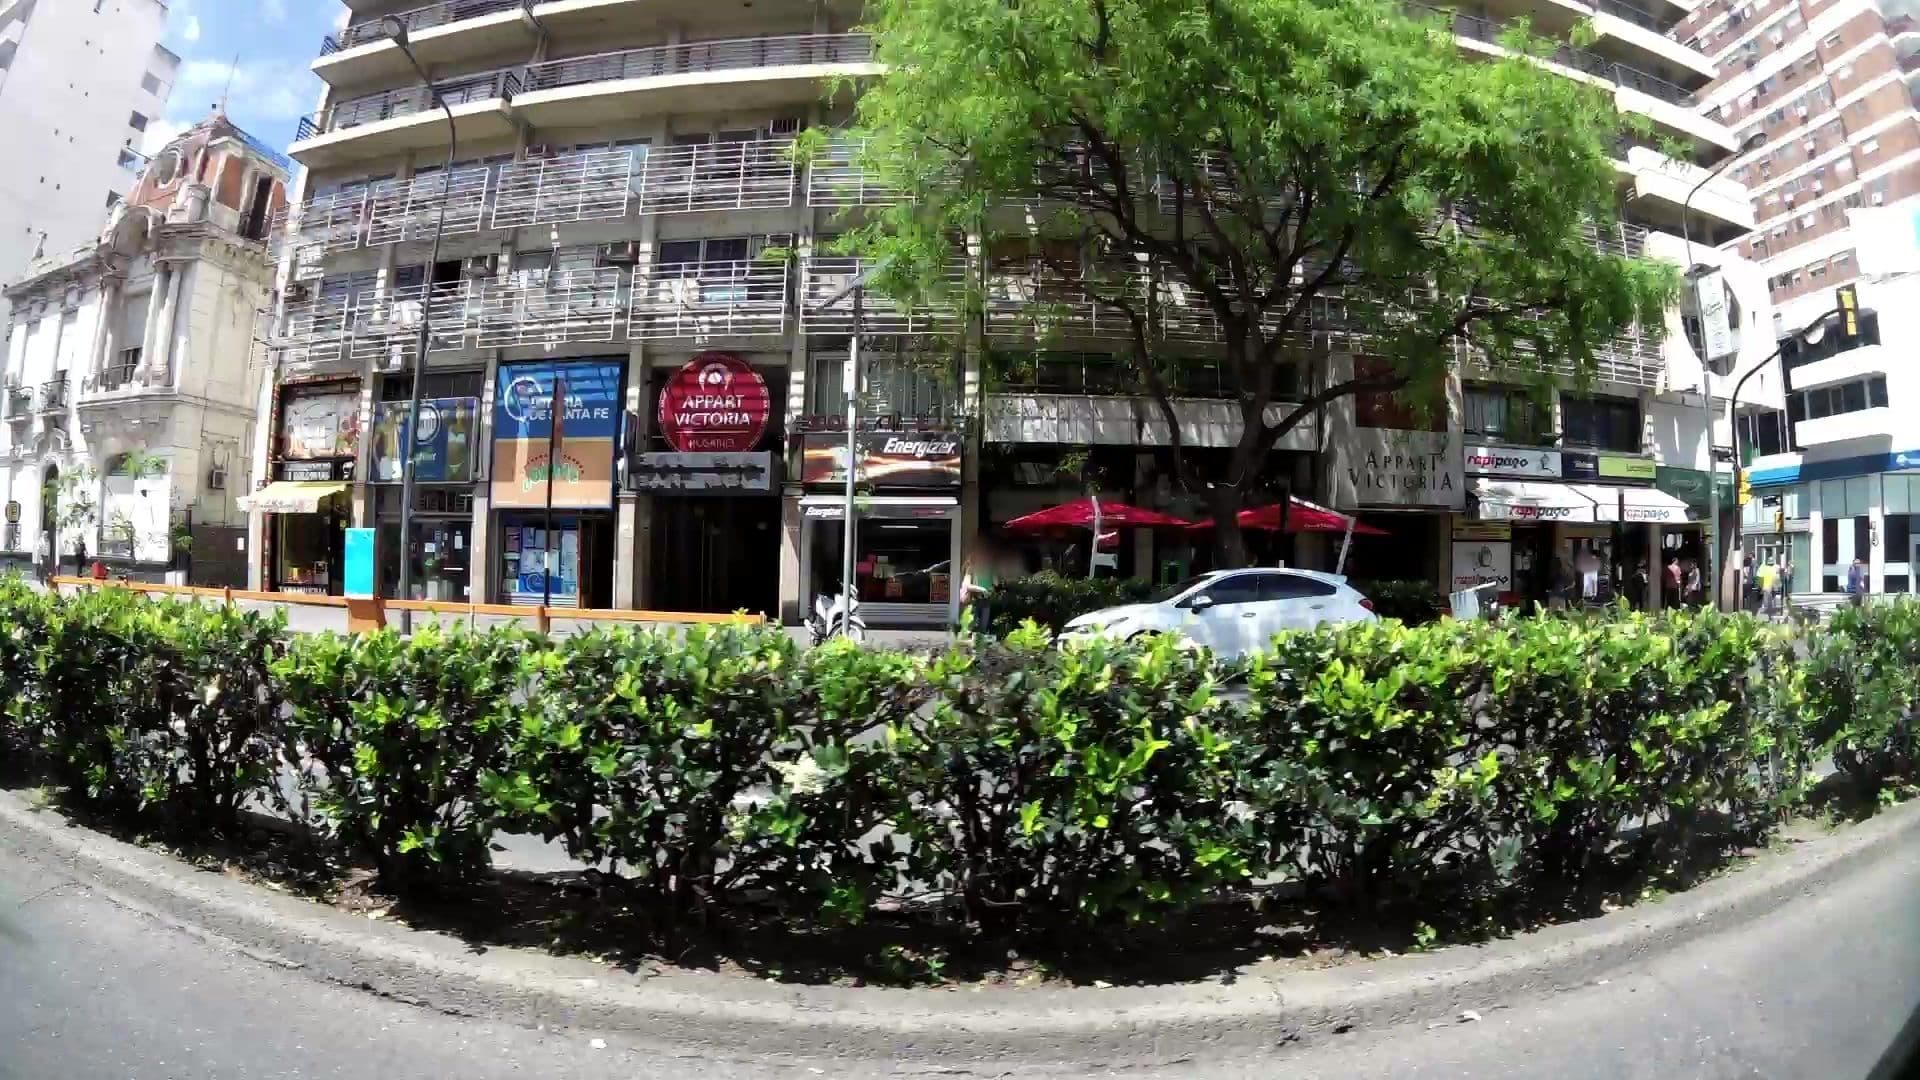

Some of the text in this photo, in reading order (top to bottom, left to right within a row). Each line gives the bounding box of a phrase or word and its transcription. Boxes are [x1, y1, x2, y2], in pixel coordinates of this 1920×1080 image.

[682, 394, 744, 409] APPART
[548, 408, 591, 420] SNTA
[593, 407, 610, 419] FE
[674, 411, 751, 427] VICTORIA
[883, 437, 957, 457] Energizer
[1365, 447, 1441, 473] APPART
[1466, 453, 1529, 470] rapipago
[1347, 468, 1453, 492] VICTORIA
[804, 506, 844, 517] Energizer
[1509, 504, 1571, 520] rapipago
